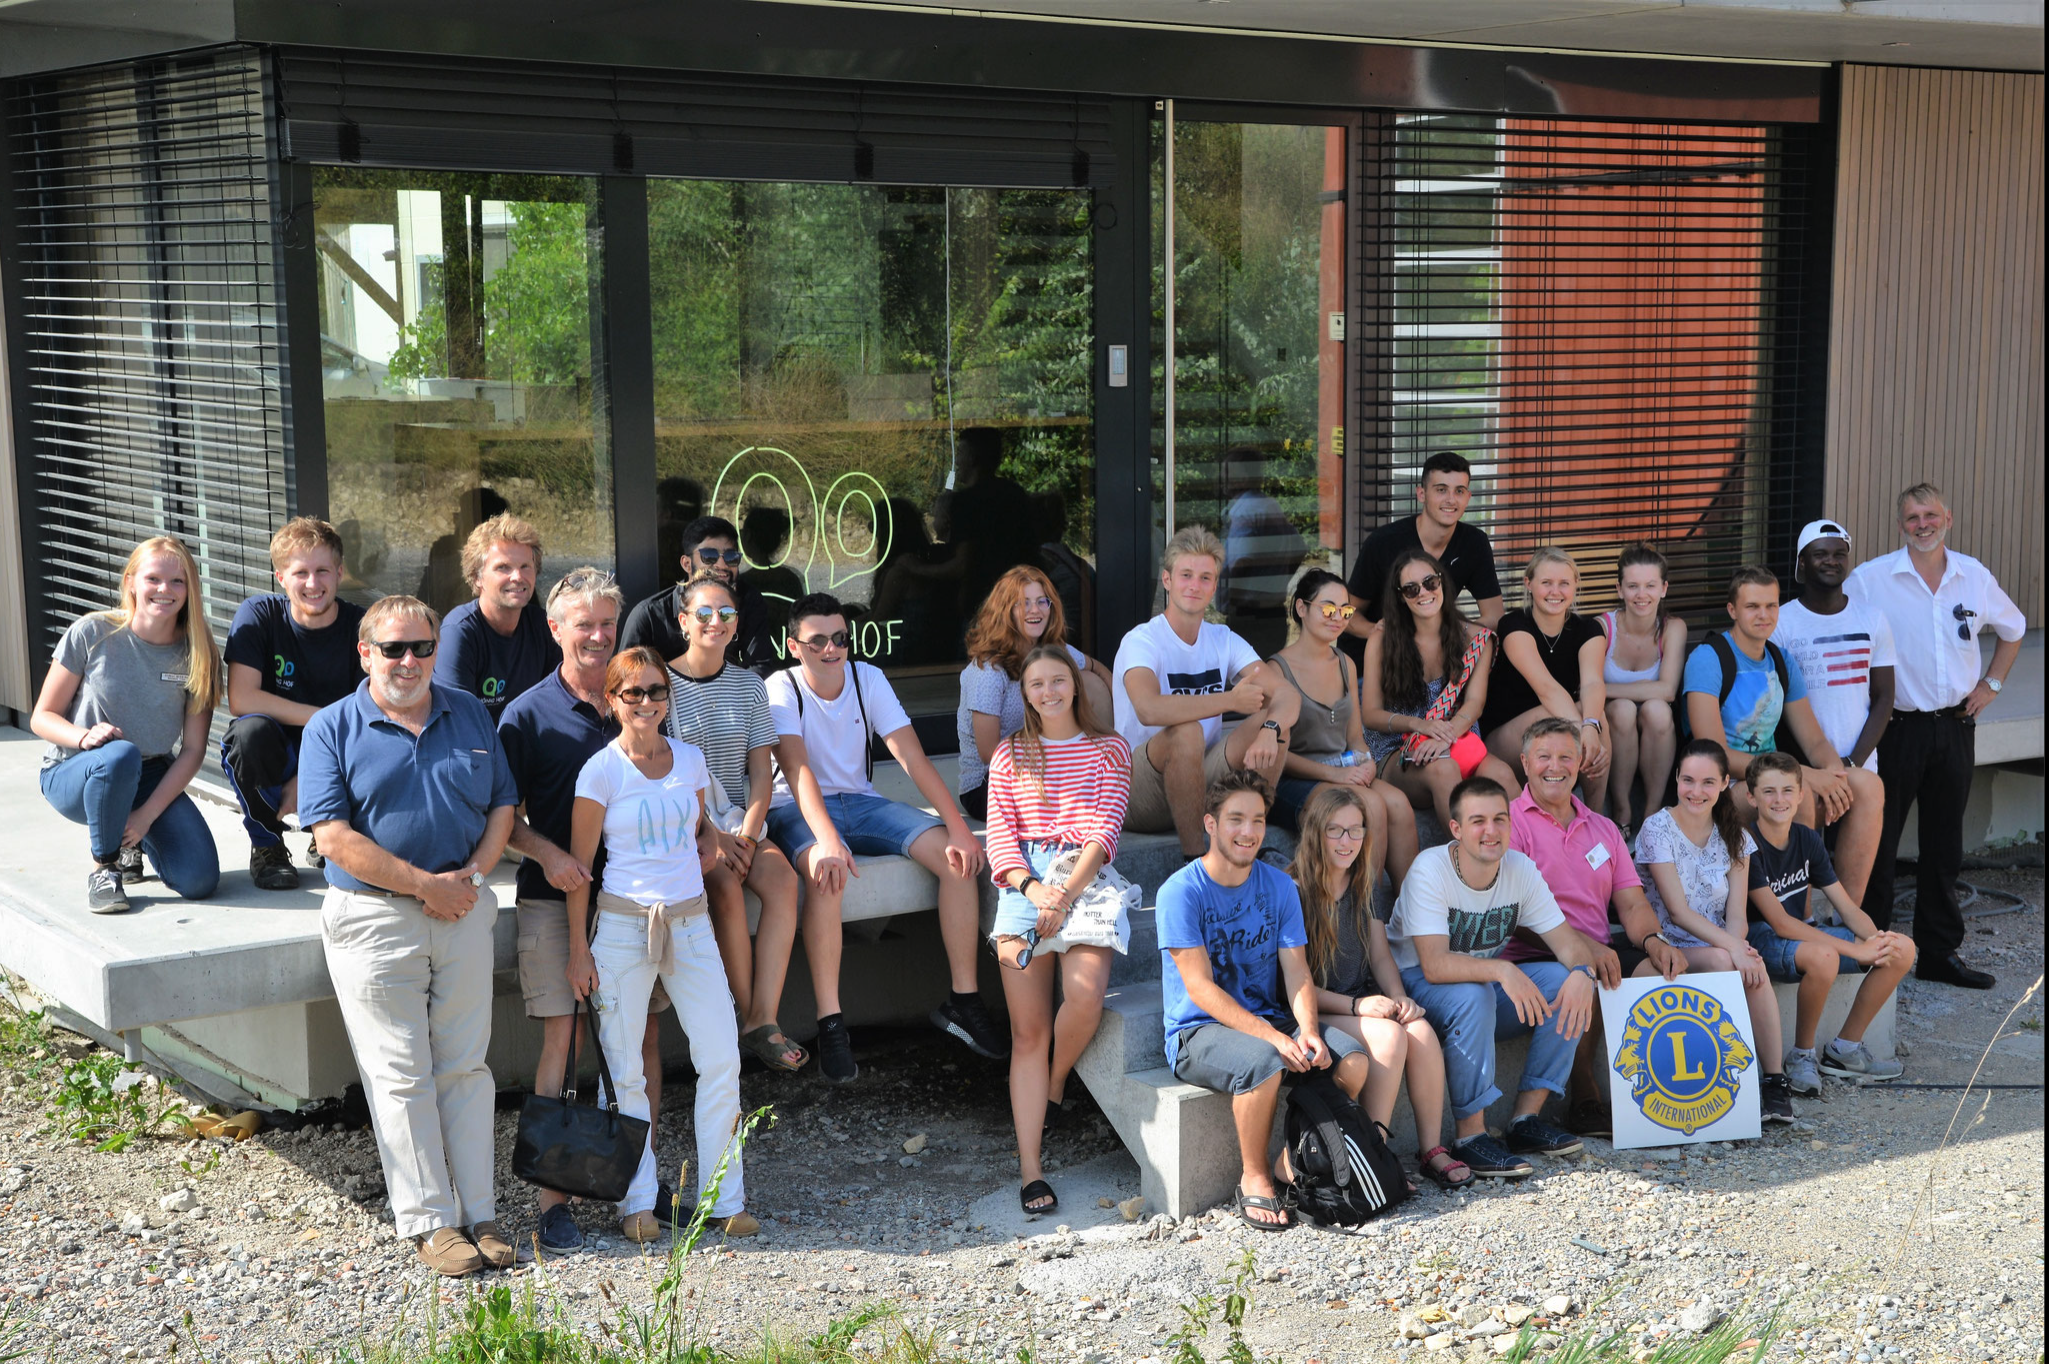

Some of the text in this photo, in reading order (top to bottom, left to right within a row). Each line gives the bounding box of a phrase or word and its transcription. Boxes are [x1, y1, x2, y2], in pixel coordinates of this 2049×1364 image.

[638, 798, 691, 855] AIX
[1637, 991, 1716, 1023] LIONS
[1667, 1031, 1706, 1082] L
[1649, 1094, 1728, 1123] INTERNATIONAL
